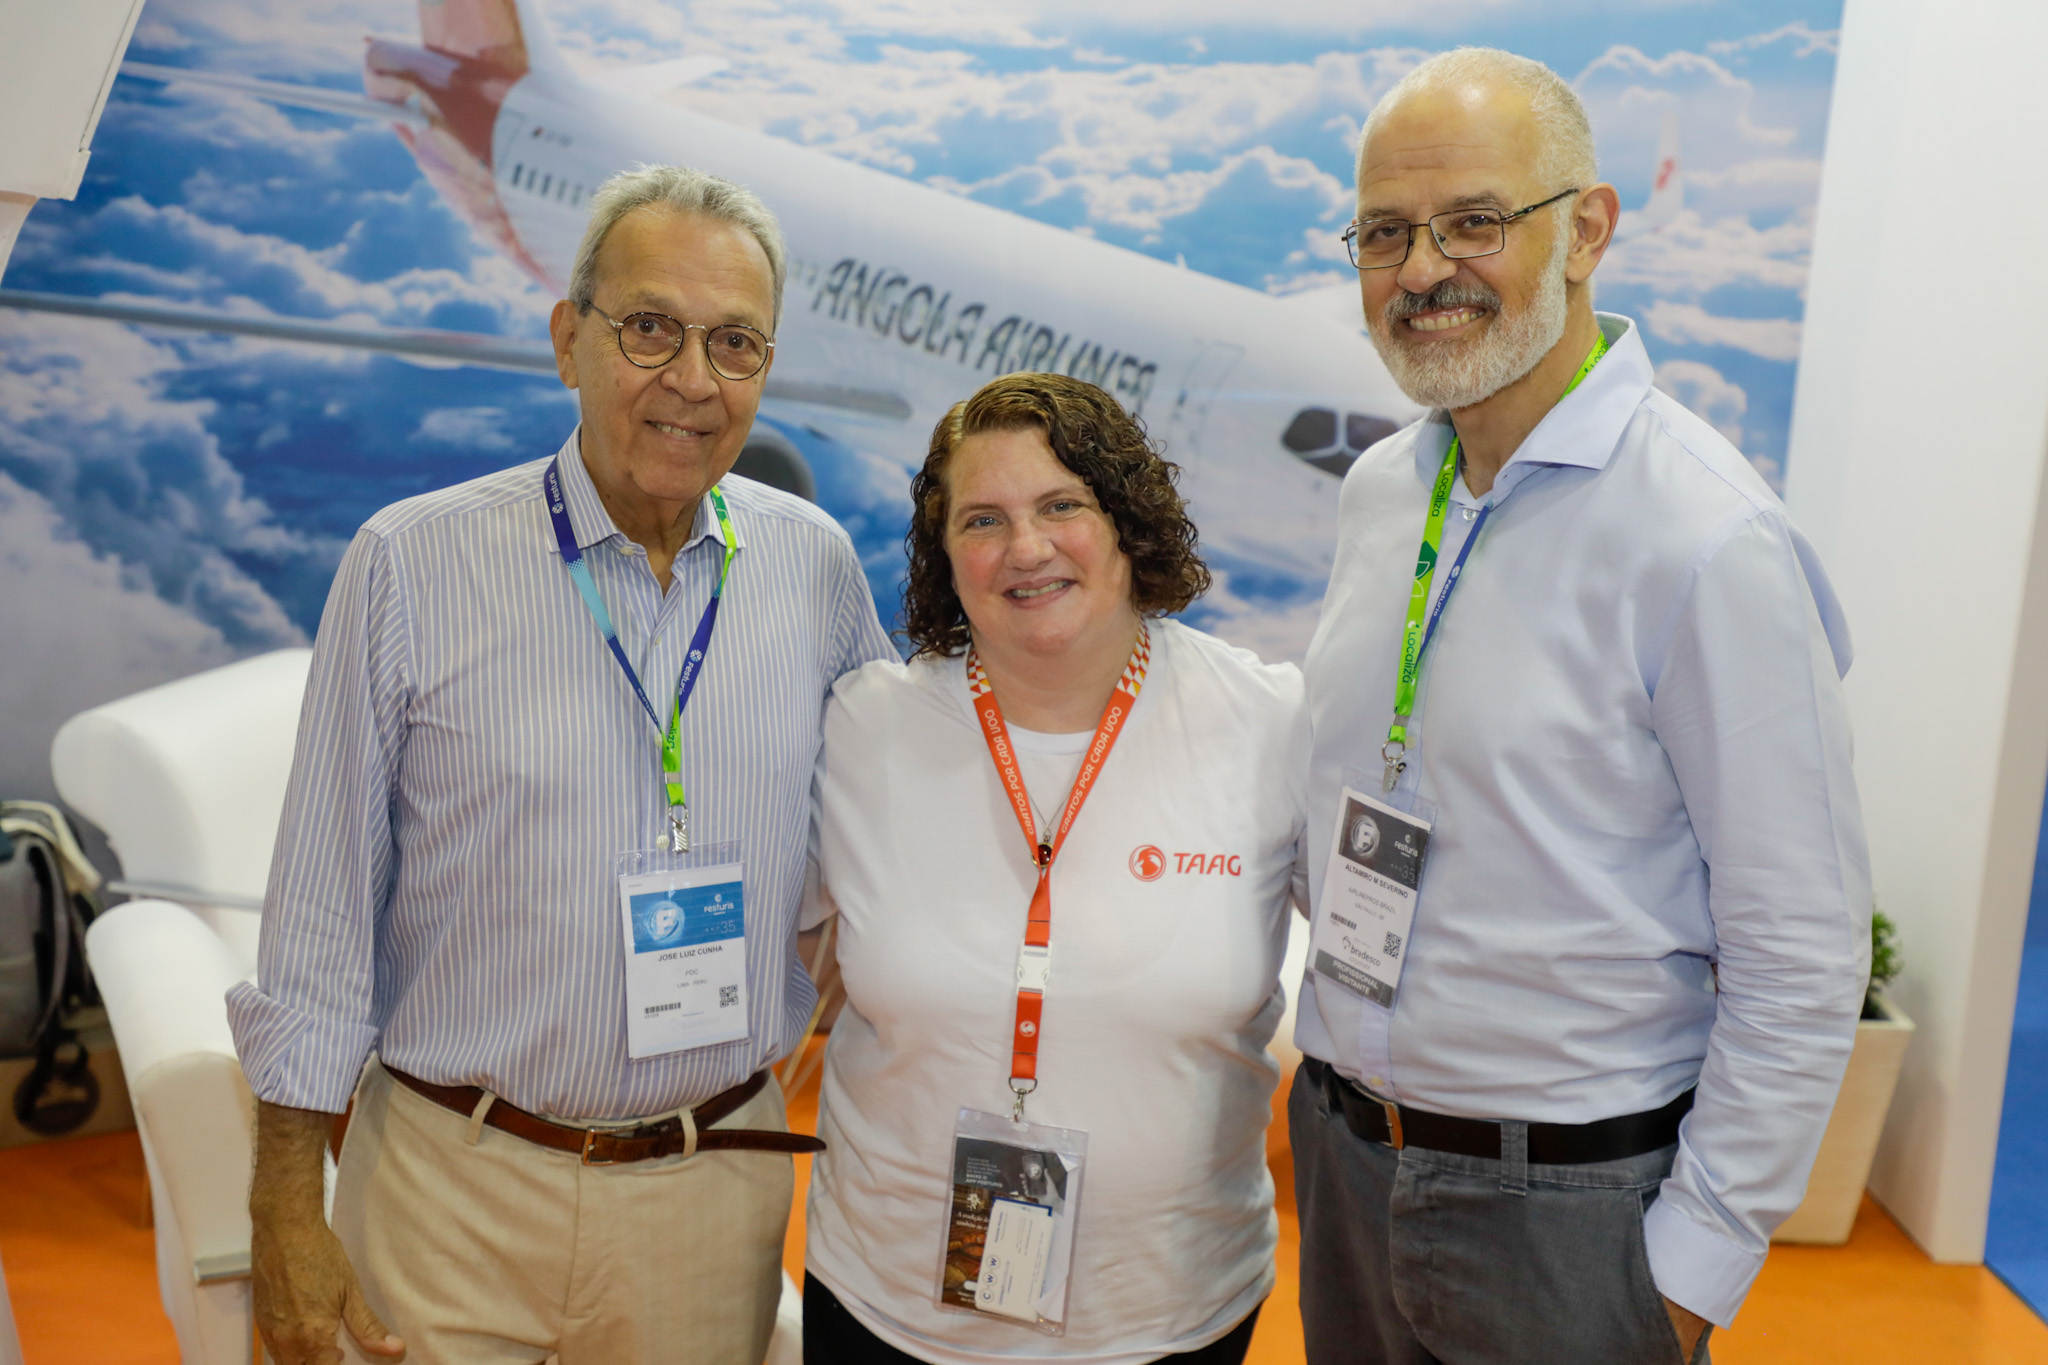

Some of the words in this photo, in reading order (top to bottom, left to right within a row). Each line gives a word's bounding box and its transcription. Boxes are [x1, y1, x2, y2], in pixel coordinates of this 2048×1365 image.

[810, 257, 988, 364] ANGOLA
[993, 735, 1012, 766] CADA
[1005, 765, 1021, 790] POR
[1061, 790, 1083, 834] GRATOS
[1079, 764, 1095, 789] POR
[1090, 733, 1110, 764] CADA
[1016, 791, 1034, 835] GRATOS
[1173, 852, 1242, 877] TAAG
[1401, 864, 1416, 882] 35
[1345, 864, 1373, 882] ALTAMIRO
[1379, 879, 1409, 899] SEVERINO
[720, 920, 736, 934] 35
[658, 952, 678, 962] JOSE
[679, 949, 696, 959] LUIZ
[697, 945, 723, 956] CUNHA
[1350, 944, 1381, 967] bradesco
[1333, 959, 1379, 990] PROFISSIONAL
[1338, 972, 1371, 995] VISITANTE
